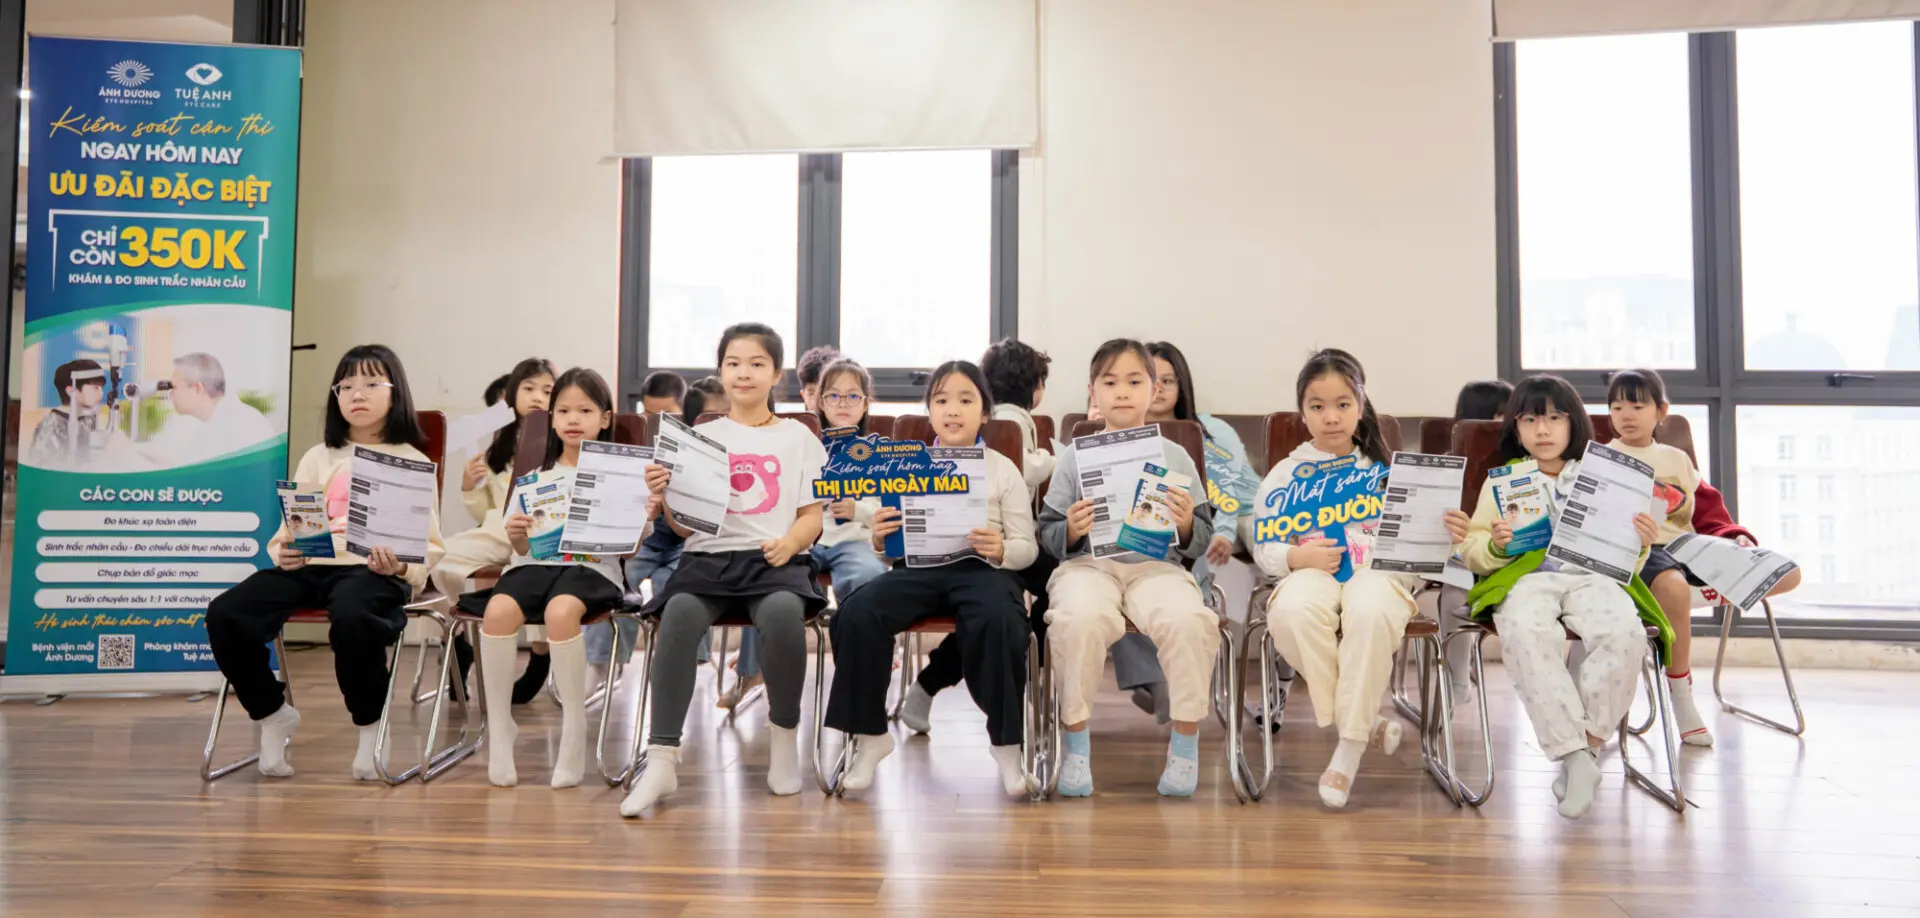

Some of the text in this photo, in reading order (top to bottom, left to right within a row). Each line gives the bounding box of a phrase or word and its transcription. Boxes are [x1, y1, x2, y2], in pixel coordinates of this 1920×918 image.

[124, 88, 160, 99] DƯƠNG
[175, 87, 232, 102] TUỆ ANH
[131, 112, 195, 137] soát
[81, 140, 243, 165] NGAY HÔM NAY
[49, 169, 272, 209] ƯU ĐÃI ĐẶC BIỆT
[81, 225, 117, 246] CHỈ
[69, 245, 116, 266] CÒN
[119, 226, 247, 270] 350K
[69, 272, 102, 285] KHÁM
[104, 275, 112, 285] &
[115, 275, 132, 285] ĐO
[134, 275, 158, 286] SINH
[160, 272, 188, 287] TRẮC
[223, 273, 246, 289] CẦU
[893, 443, 923, 453] DƯƠNG
[866, 457, 899, 476] soát
[929, 461, 955, 480] nay
[814, 473, 967, 499] THỊ LỰC NGÀY MAI
[1267, 463, 1391, 513] Mắt sáng
[80, 485, 223, 506] CÁC CON SẼ ĐƯỢC
[104, 517, 197, 528] Đo khúc xạ toàn diện
[1257, 511, 1313, 542] HỌC
[1317, 493, 1385, 528] ĐƯỜN
[45, 543, 64, 552] Sinh
[65, 541, 84, 552] trắc
[110, 541, 128, 552] cầu
[134, 543, 147, 552] Đo
[148, 541, 173, 552] chiều
[175, 543, 190, 552] dài
[191, 543, 208, 553] trục
[233, 541, 251, 552] cầu
[97, 566, 199, 579] Chụp bản đồ giác mạc
[66, 593, 77, 604] Tư
[78, 593, 95, 604] vấn
[96, 594, 129, 606] chuyên
[131, 594, 147, 604] sâu
[149, 594, 162, 604] 1:1
[164, 594, 178, 604] với
[61, 614, 90, 629] sinh
[32, 640, 94, 653] Bệnh viện mắt
[144, 642, 172, 653] Phòng
[174, 641, 198, 651] khám
[45, 652, 94, 663] Ánh Dương
[183, 653, 197, 663] Tuệ
